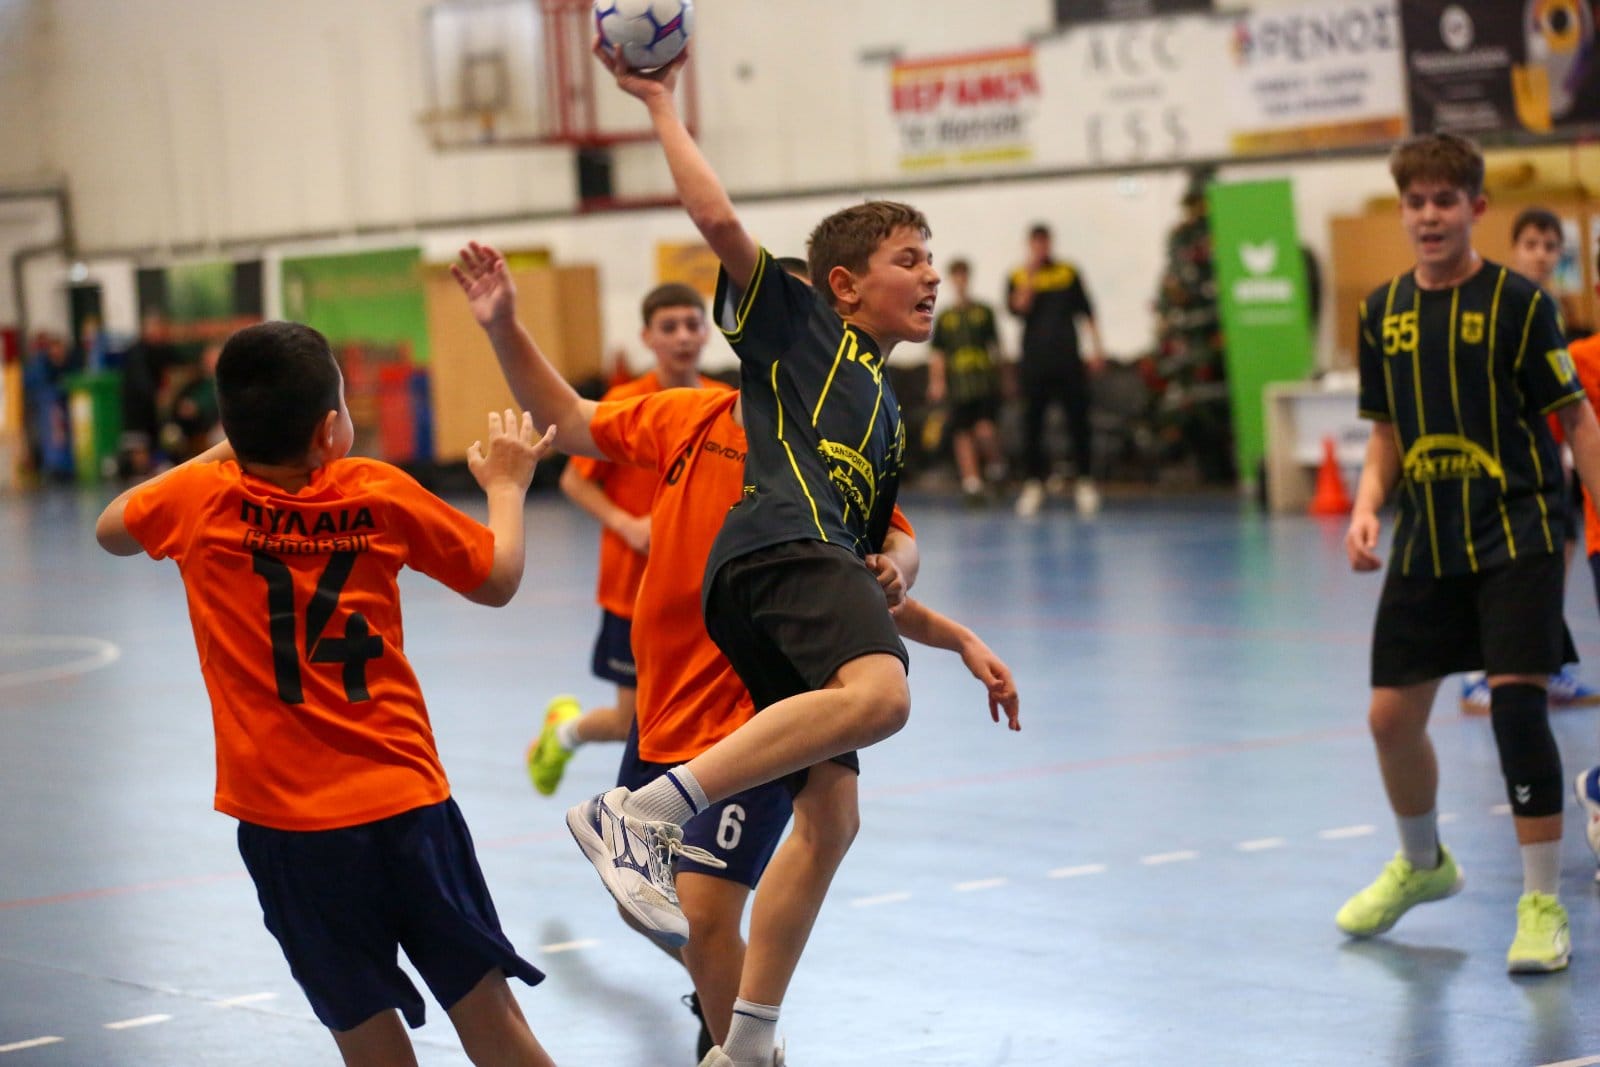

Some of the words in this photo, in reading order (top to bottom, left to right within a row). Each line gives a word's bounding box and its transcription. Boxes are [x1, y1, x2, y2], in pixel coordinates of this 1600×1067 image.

[1383, 311, 1419, 355] 55
[240, 499, 375, 536] ΠΥΛΑΙΑ
[252, 549, 384, 705] 14
[716, 803, 746, 850] 6
